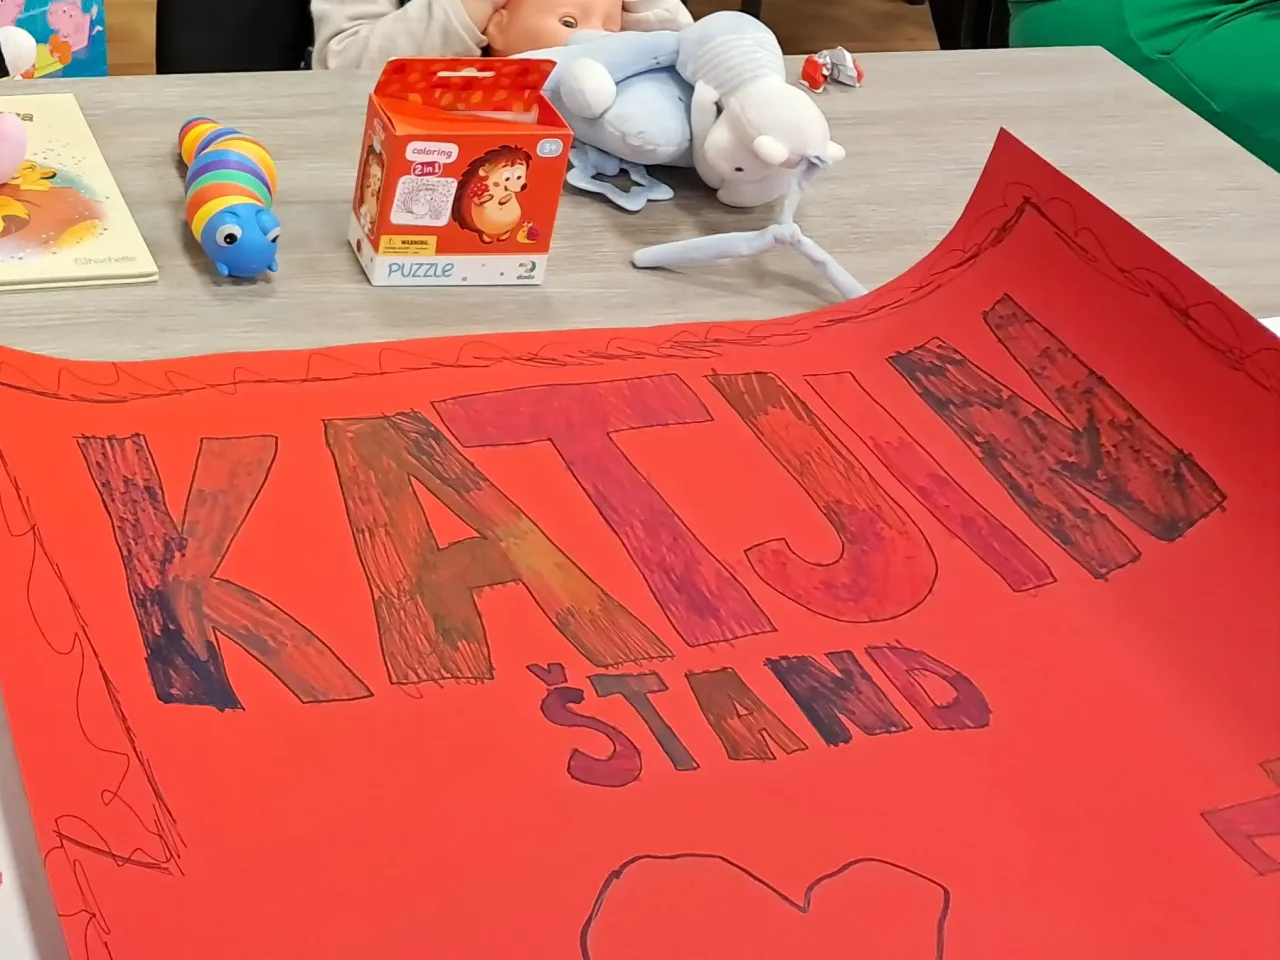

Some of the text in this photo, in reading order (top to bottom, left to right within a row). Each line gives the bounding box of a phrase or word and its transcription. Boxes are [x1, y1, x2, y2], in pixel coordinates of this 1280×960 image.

[411, 147, 453, 159] coloring
[542, 143, 556, 153] 3+
[74, 292, 1228, 711] KATJIN
[525, 642, 993, 787] ŠTAND
